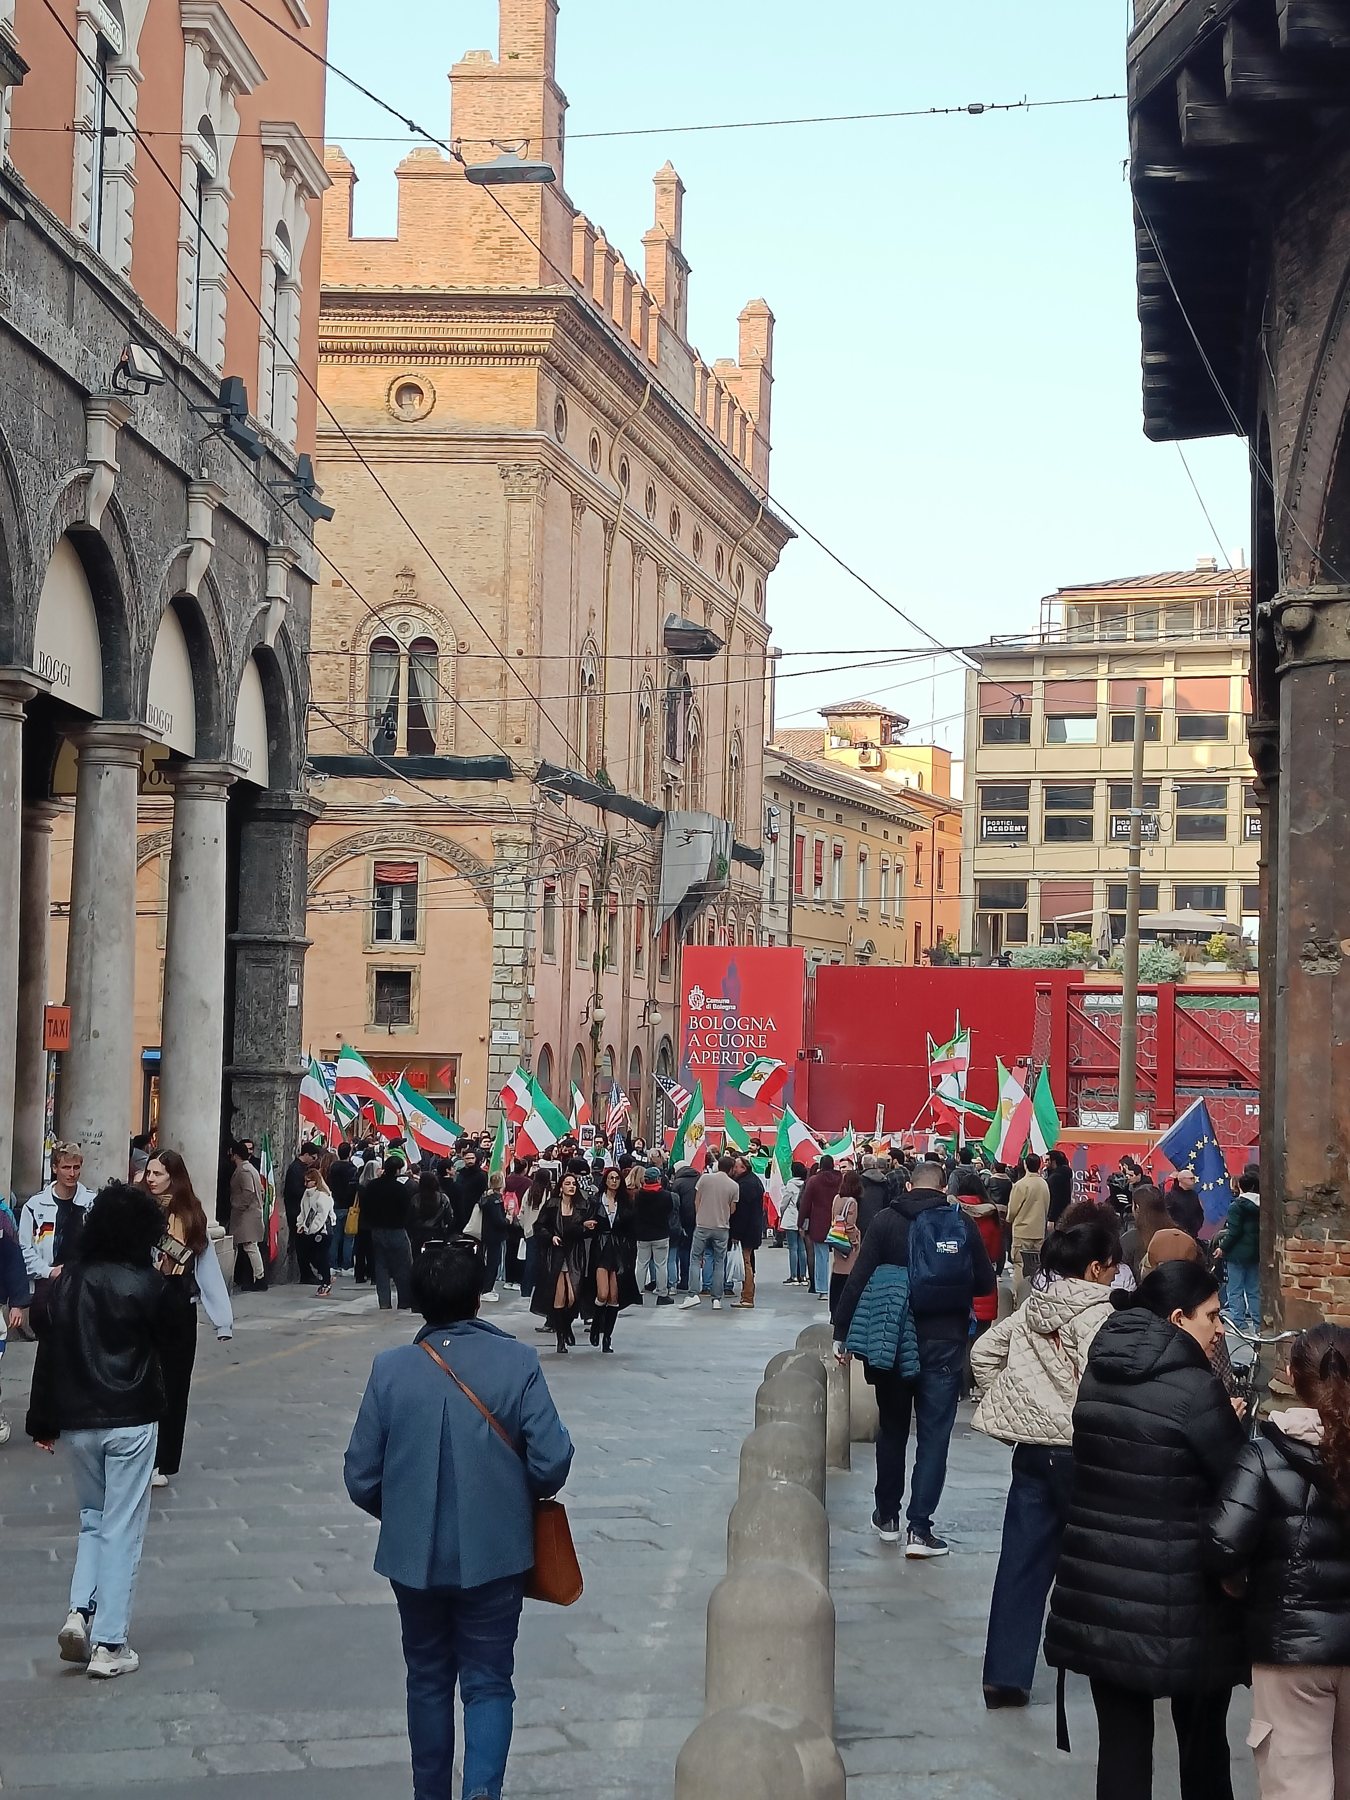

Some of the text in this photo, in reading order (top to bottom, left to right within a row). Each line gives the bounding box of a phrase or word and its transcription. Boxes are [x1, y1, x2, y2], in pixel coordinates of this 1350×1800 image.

[39, 651, 71, 687] BOGGI
[148, 704, 173, 733] BOGGI
[47, 1018, 69, 1039] TAXI
[688, 1015, 777, 1031] BOLOGNA
[687, 1033, 768, 1049] A CUORE
[687, 1050, 758, 1066] APERTO
